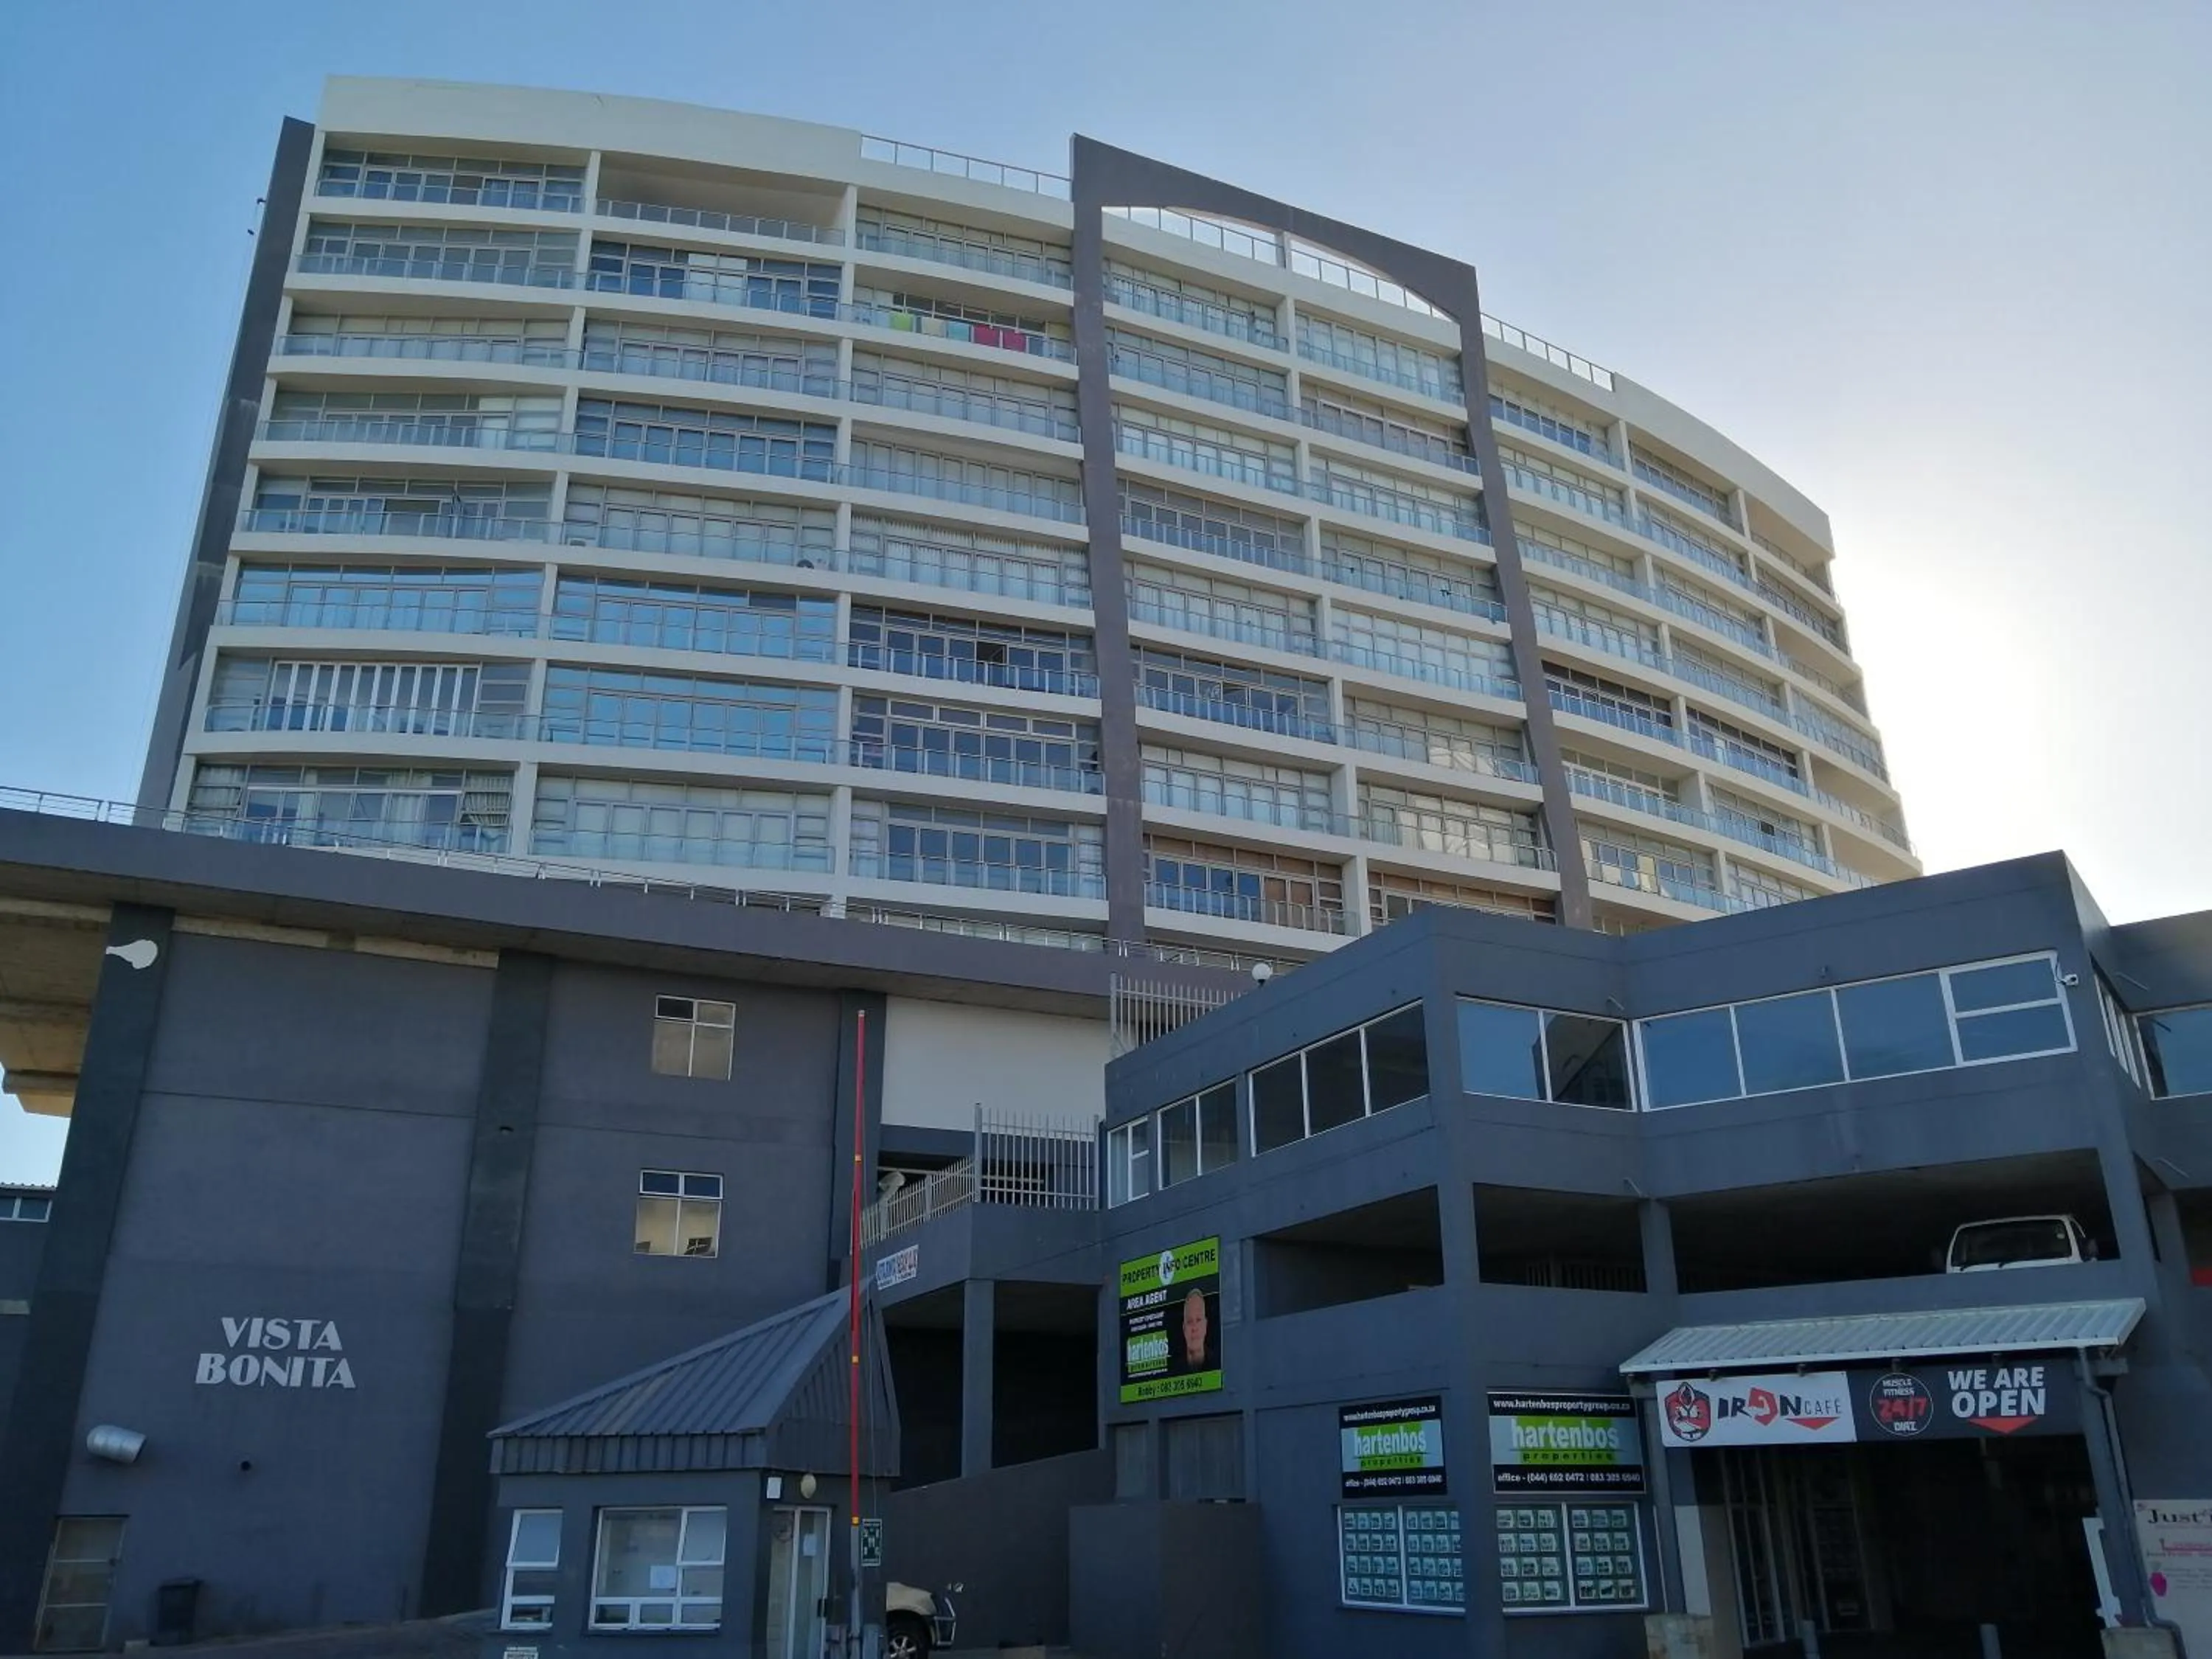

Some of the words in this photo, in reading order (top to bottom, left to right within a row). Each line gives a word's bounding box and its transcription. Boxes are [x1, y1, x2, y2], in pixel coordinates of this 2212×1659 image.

[1121, 1265, 1161, 1285] PROPERTY
[1183, 1248, 1216, 1267] CENTRE
[1145, 1290, 1168, 1304] AGENT
[220, 1317, 343, 1351] VISTA
[195, 1353, 357, 1389] BONITA
[1947, 1369, 1986, 1391] WE
[1992, 1367, 2045, 1388] ARE
[1951, 1388, 2047, 1419] OPEN
[1354, 1425, 1427, 1457] hartenbos
[1512, 1418, 1620, 1449] hartenbos
